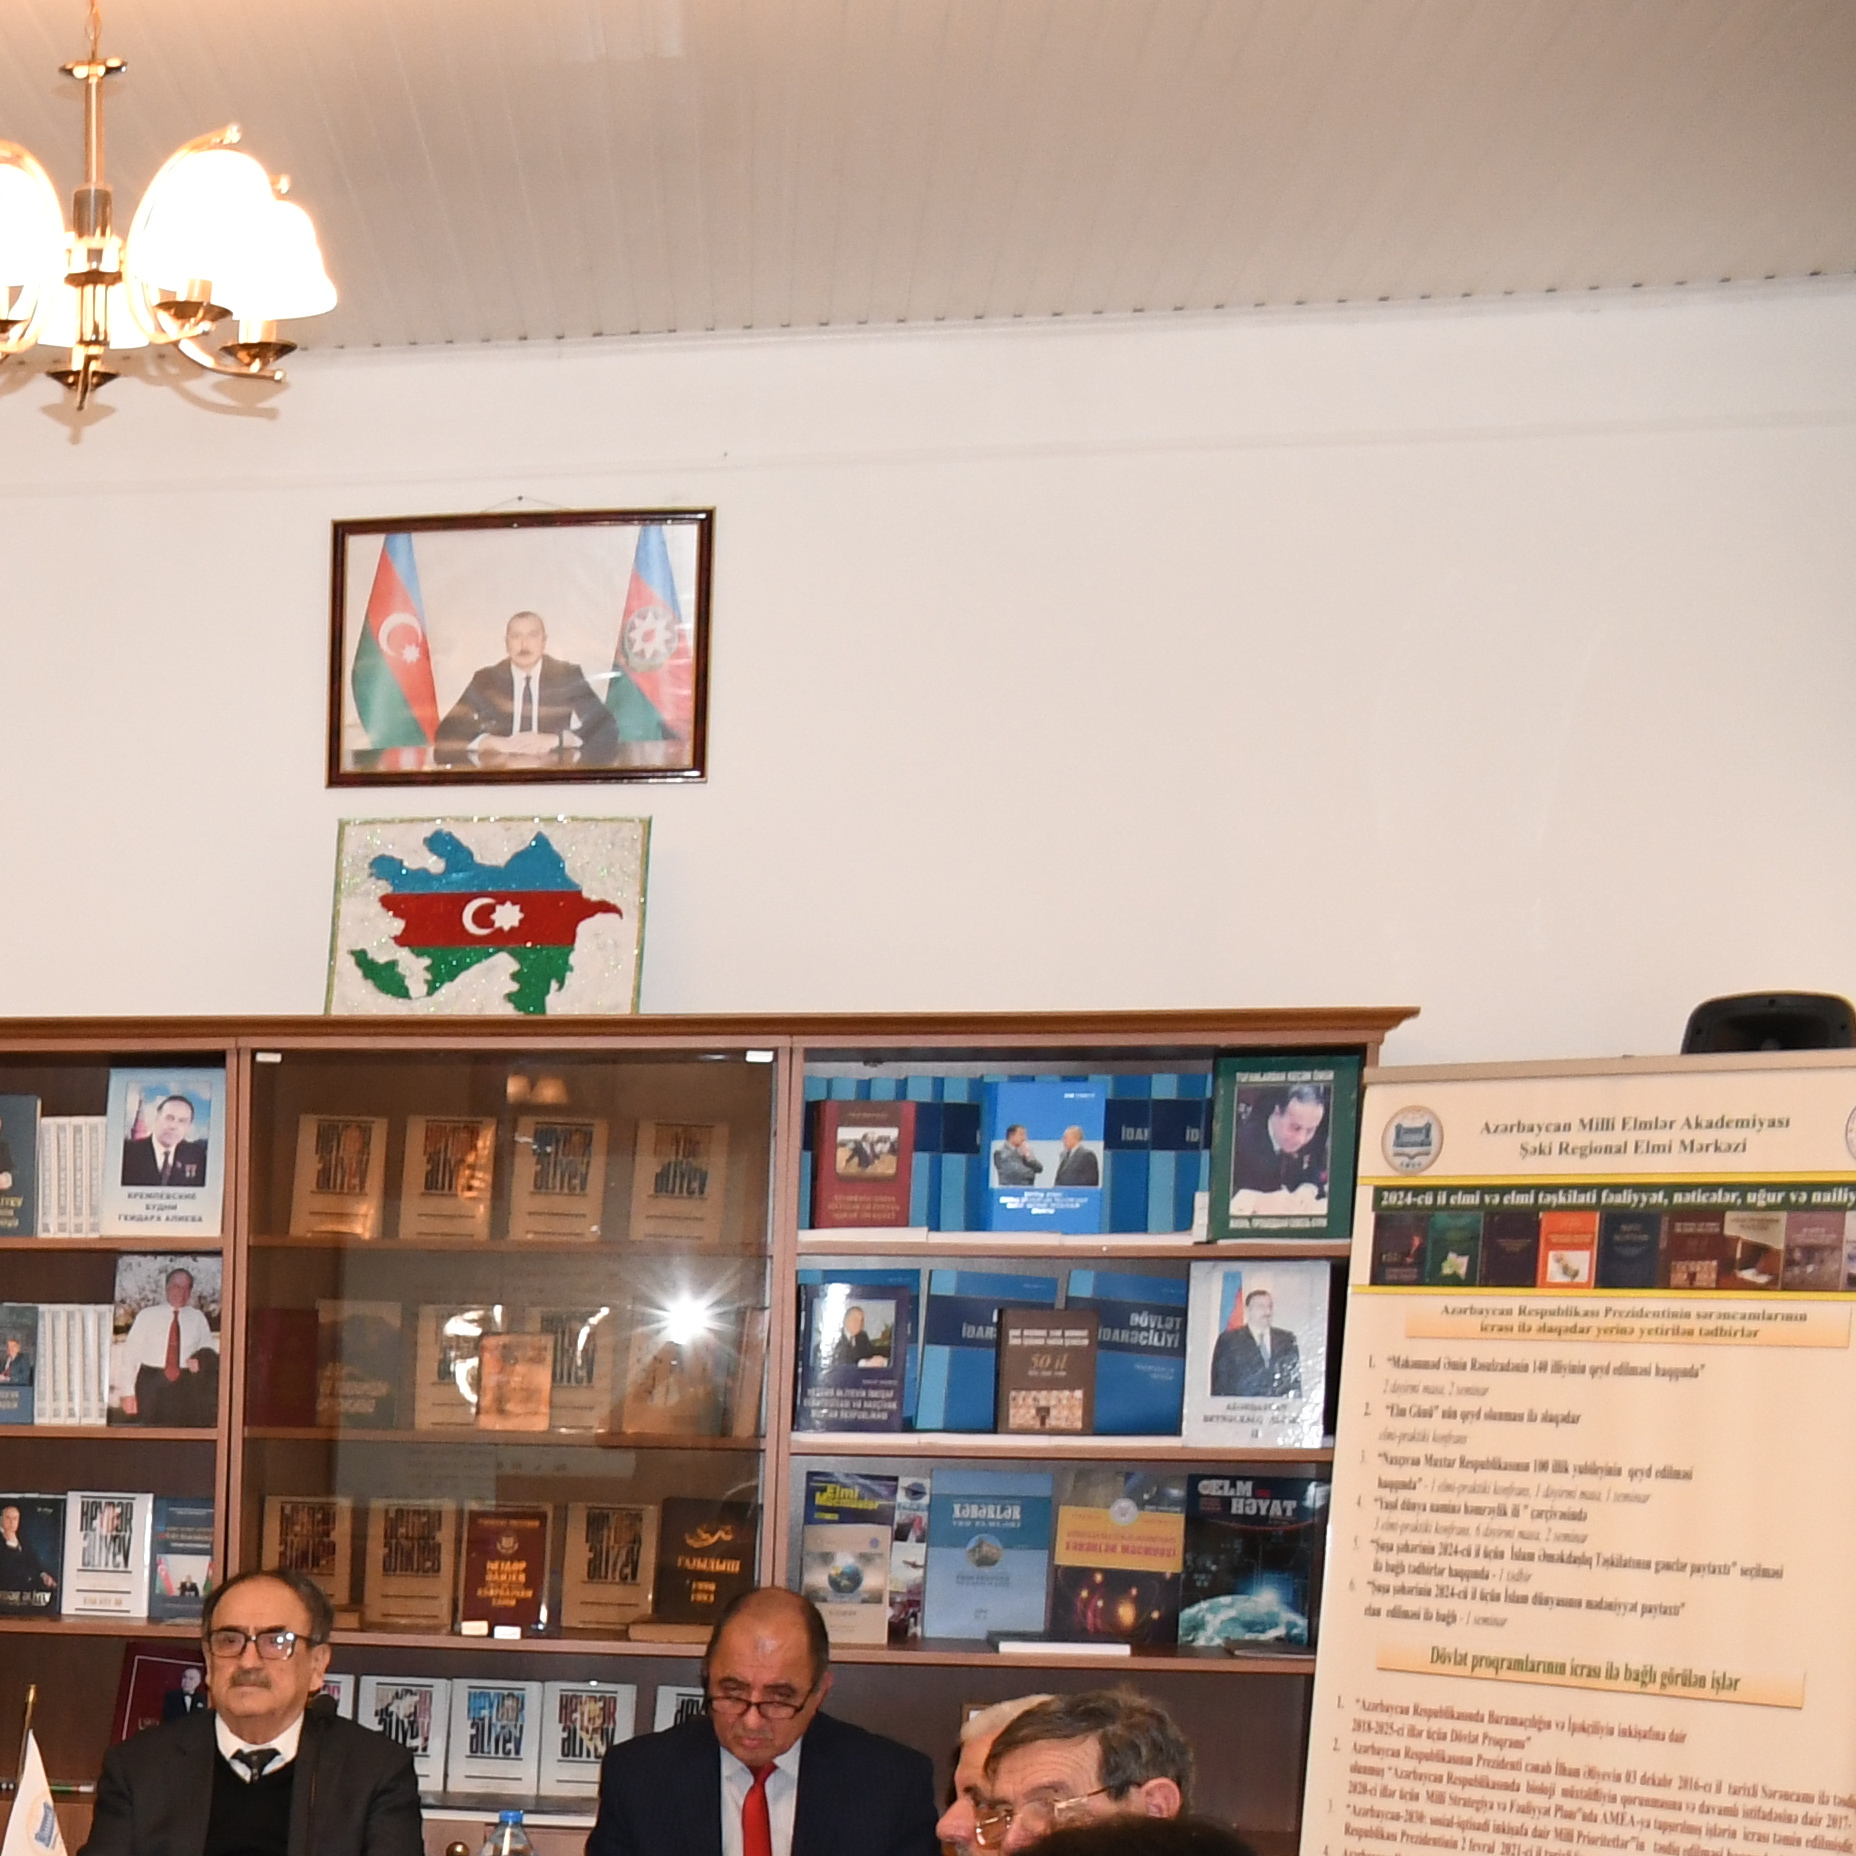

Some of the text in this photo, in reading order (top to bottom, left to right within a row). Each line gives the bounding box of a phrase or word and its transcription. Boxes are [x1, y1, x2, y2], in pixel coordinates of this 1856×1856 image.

[1480, 1113, 1791, 1137] Azərbaycan Milli Elmlər Akademiyası
[1519, 1137, 1748, 1160] Şəki Regional Elmi Mərkəzi
[1449, 1190, 1480, 1206] elmi
[1484, 1193, 1501, 1206] və
[1502, 1189, 1535, 1206] elmi
[1789, 1190, 1808, 1205] və
[1129, 1309, 1183, 1330] DÖVLƏT
[1440, 1304, 1514, 1319] Azərbaycan
[1517, 1304, 1600, 1320] Respublikası
[1603, 1305, 1693, 1320] Prezidentinin
[1098, 1325, 1181, 1349] İDARƏÇİLİYİ
[953, 1503, 1021, 1520] XƏBƏRLƏR
[1230, 1497, 1298, 1517] HƏYAT
[1430, 1645, 1468, 1667] Dövlət
[1470, 1653, 1567, 1676] proqramlarının
[1623, 1663, 1656, 1688] bağlı
[1659, 1666, 1707, 1690] görülən
[1710, 1669, 1742, 1695] işlər
